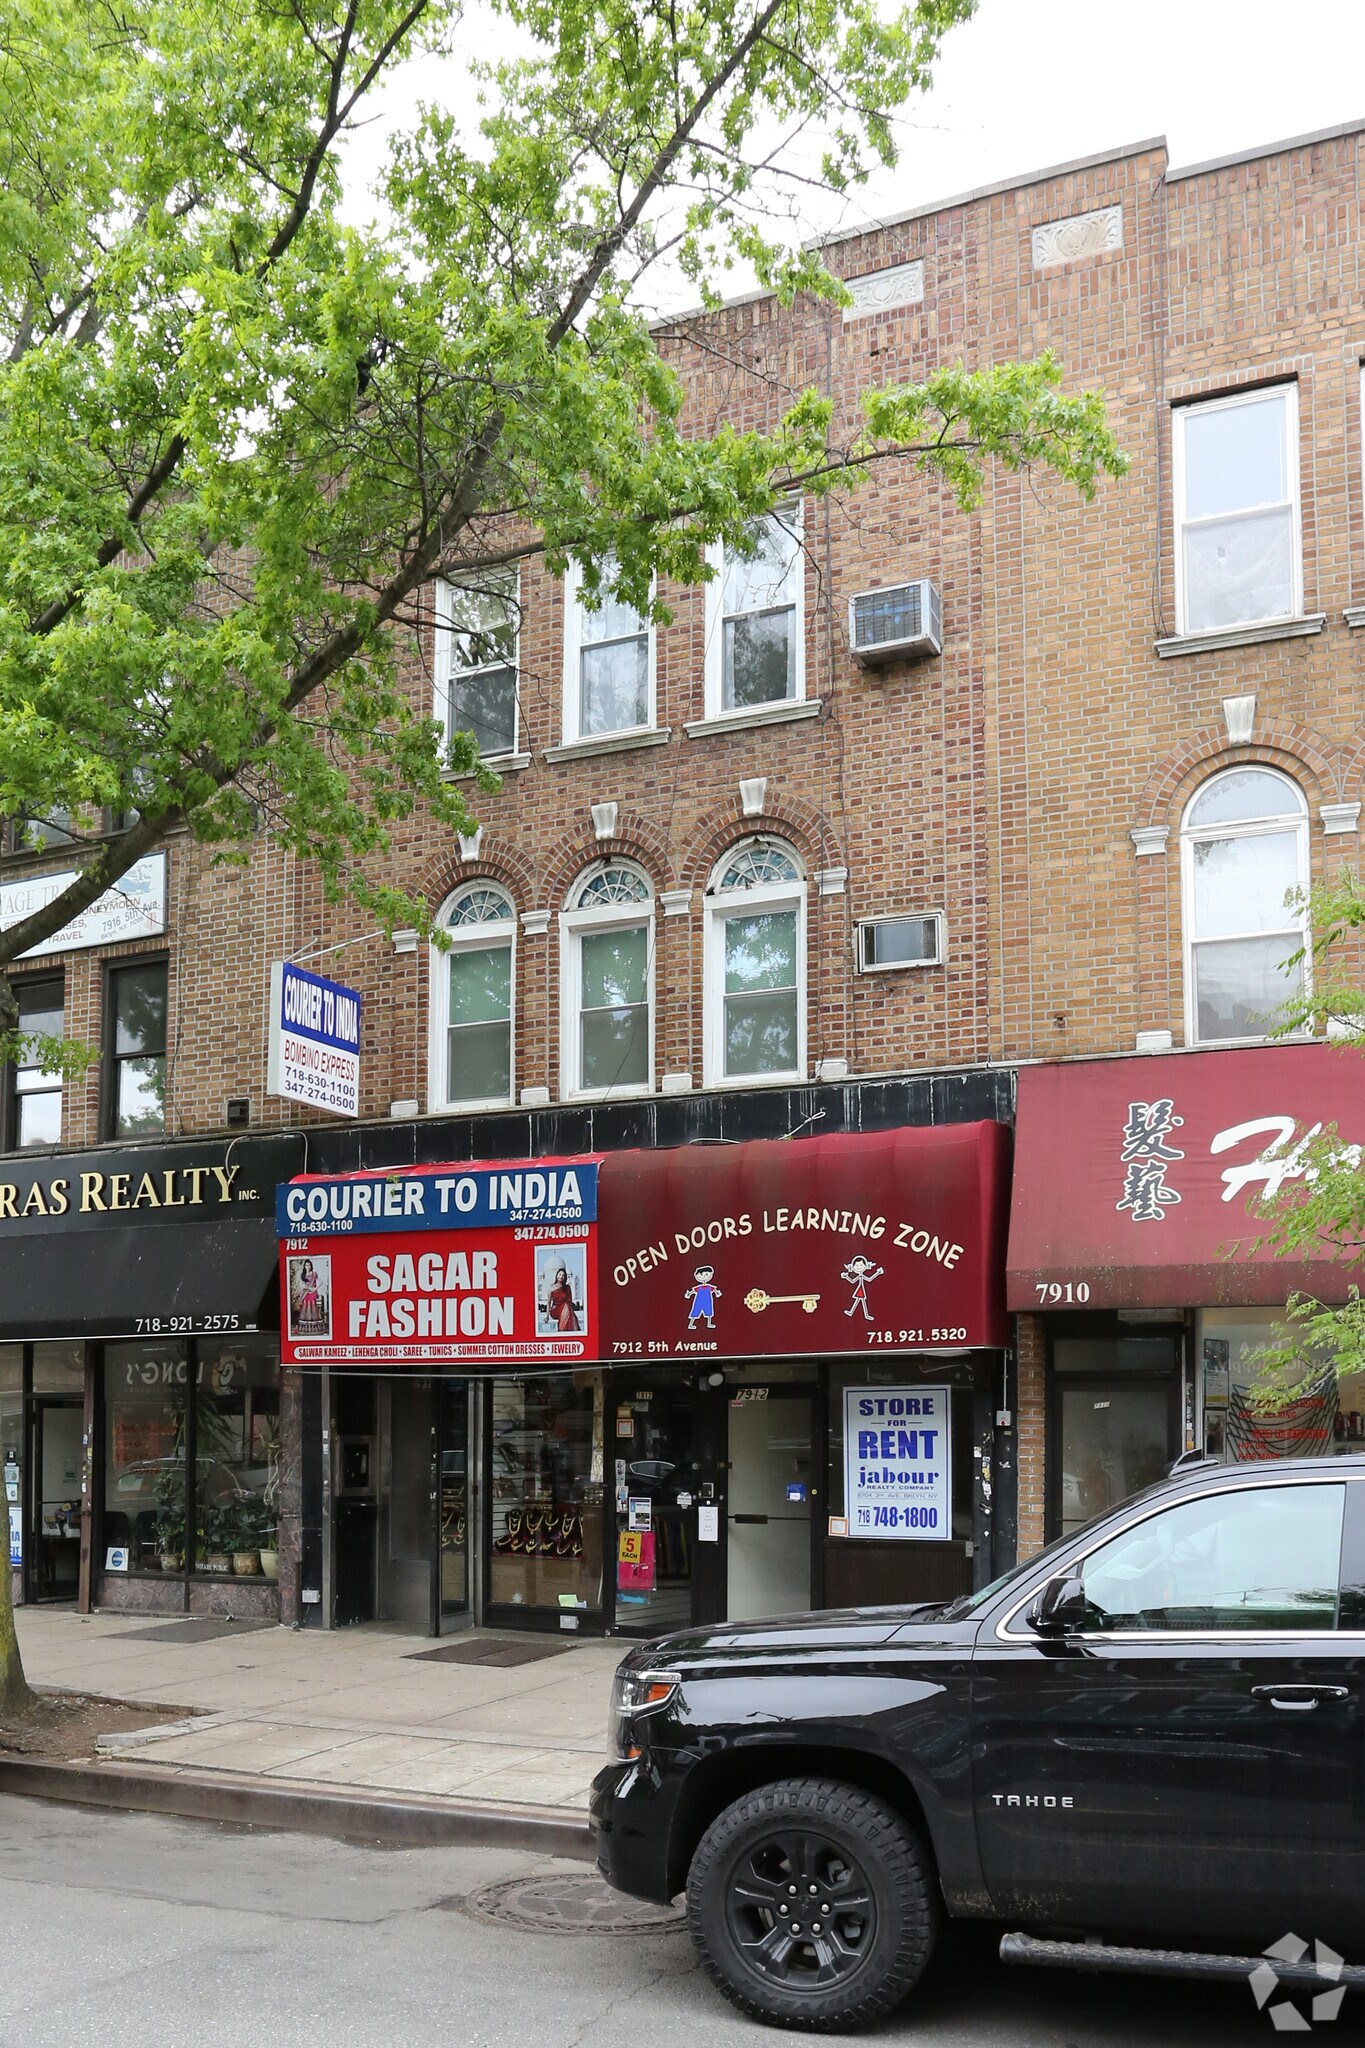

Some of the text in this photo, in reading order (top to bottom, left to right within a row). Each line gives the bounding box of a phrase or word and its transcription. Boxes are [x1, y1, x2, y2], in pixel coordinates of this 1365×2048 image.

[102, 916, 121, 932] 7916
[125, 908, 139, 923] 5th
[284, 974, 358, 1045] COURIER TO INDIA
[285, 1039, 355, 1082] BOMBINO EXPRESS
[285, 1066, 355, 1097] 718-630-1100
[285, 1080, 355, 1111] 347-274-0500
[79, 1165, 240, 1212] REALTY
[238, 1189, 260, 1201] INC.
[286, 1170, 582, 1222] COURIER TO INDIA
[509, 1206, 582, 1222] 347-274-0500
[290, 1219, 353, 1234] 718-630-1100
[514, 1223, 590, 1241] 347.274.0500
[285, 1237, 308, 1251] 7912
[613, 1207, 965, 1287] OPEN DOORS LEARNING ZONE
[366, 1250, 498, 1294] SAGAR
[1035, 1282, 1090, 1304] 7910
[135, 1315, 239, 1332] 718-921-2575
[348, 1296, 515, 1338] FASHION
[612, 1339, 718, 1354] 7912 5th Avenue
[866, 1327, 967, 1344] 718.921.5320
[298, 1342, 581, 1358] SALWAR KAMEEZ LEHENGA CHOLI SAREE TUNICS SUMMER COTTON DRESSES JEWELRY
[736, 1389, 768, 1400] 7912
[859, 1398, 934, 1416] STORE
[858, 1430, 938, 1459] RENT
[857, 1466, 940, 1488] jabour
[858, 1509, 870, 1523] 718
[992, 1794, 1074, 1808] TAHOE
